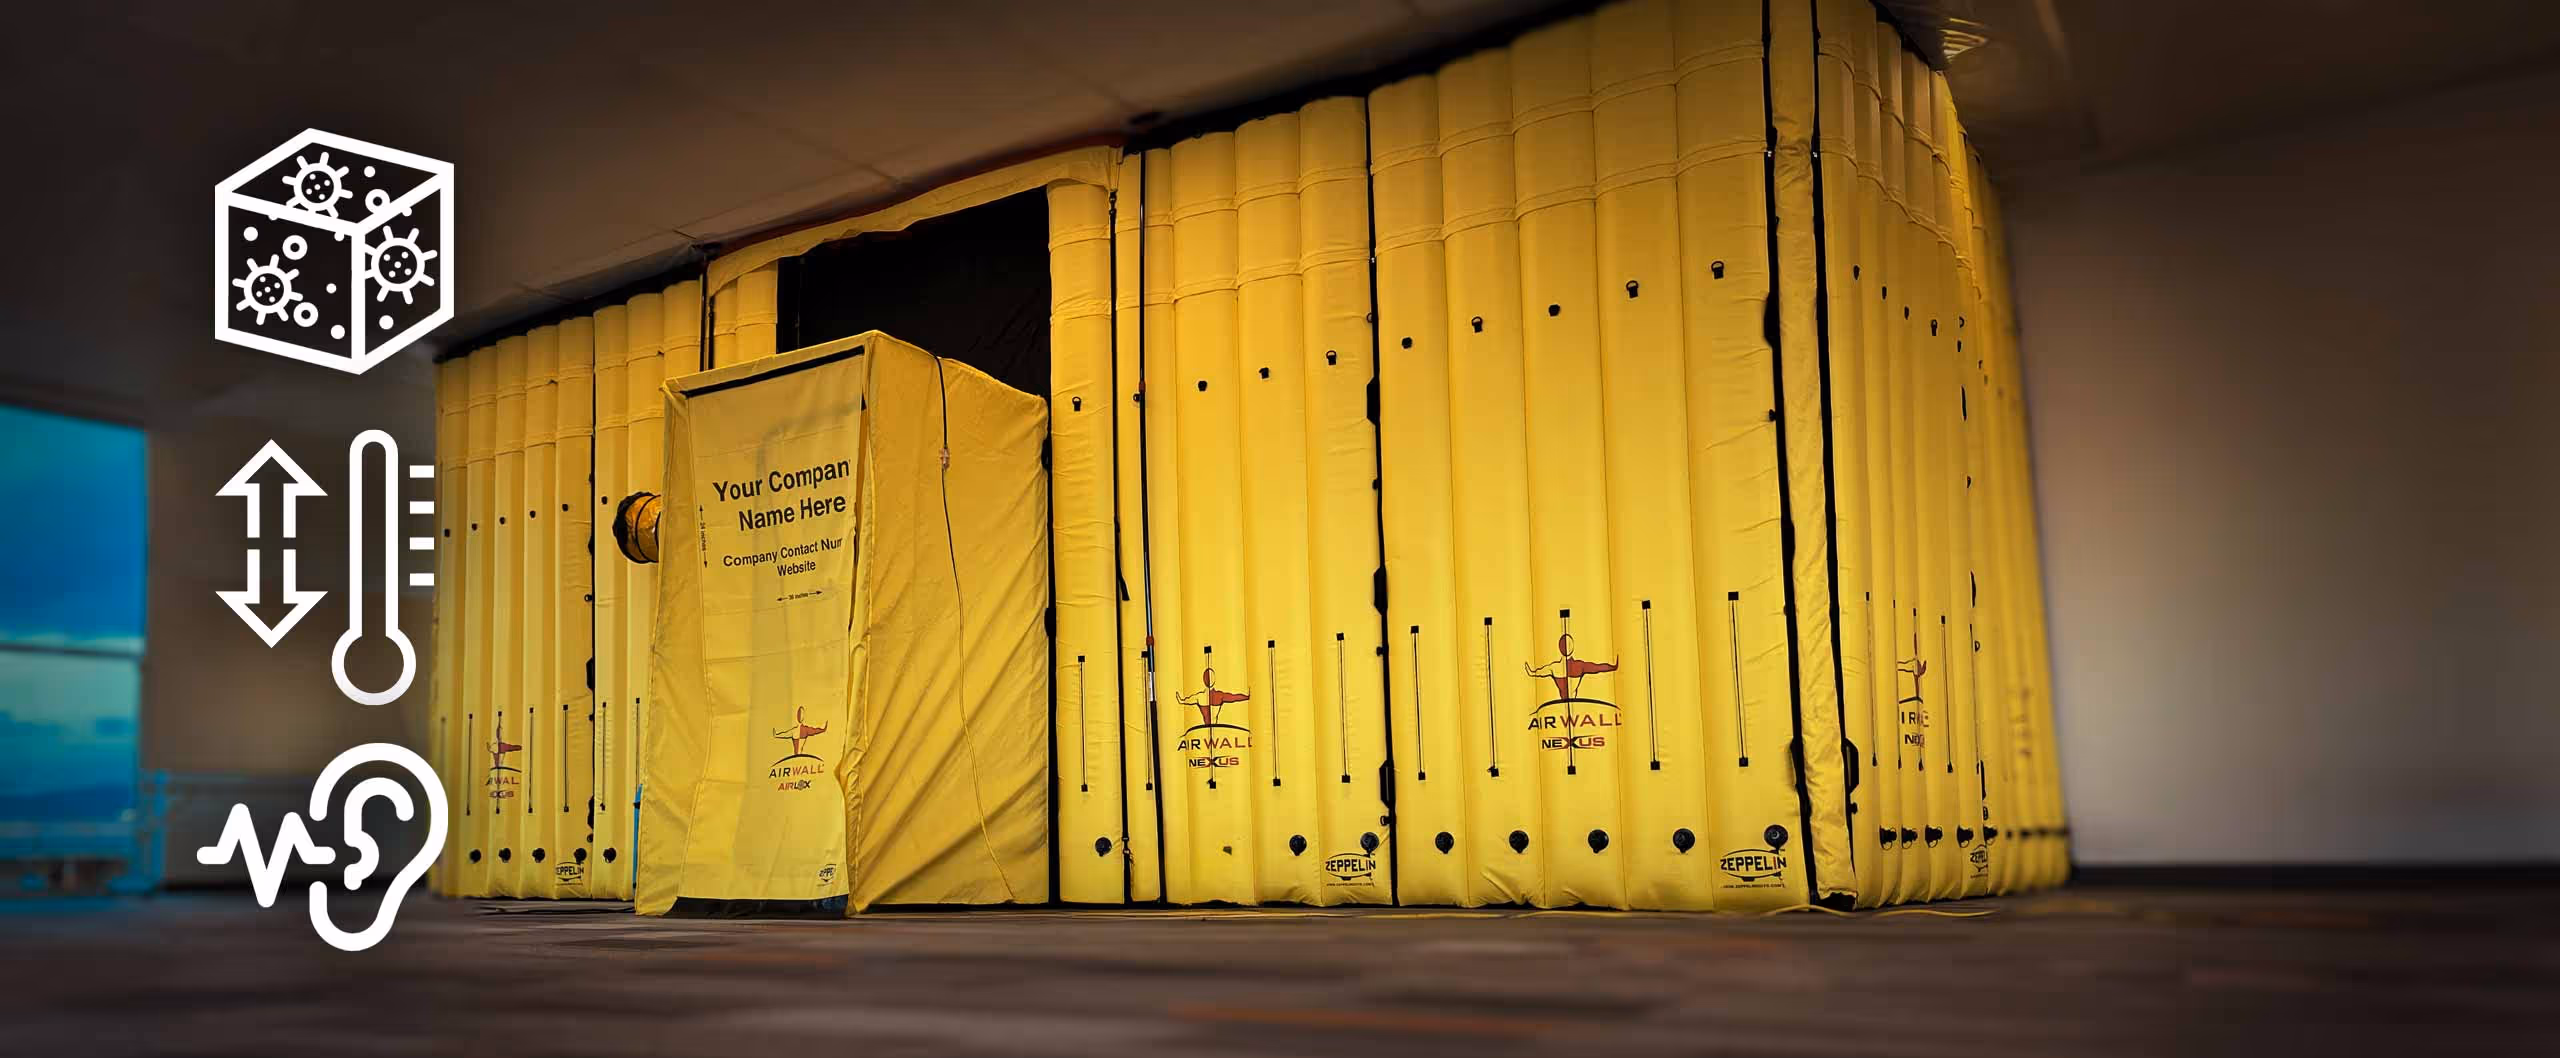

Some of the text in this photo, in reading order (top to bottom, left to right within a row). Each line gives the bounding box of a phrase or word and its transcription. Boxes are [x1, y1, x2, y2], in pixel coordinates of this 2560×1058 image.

[712, 459, 851, 502] Your Compan
[738, 495, 846, 531] Name Here
[723, 550, 778, 567] Company
[780, 541, 818, 559] Contact
[777, 560, 816, 577] Website
[1528, 713, 1622, 730] AIRWALL
[1177, 737, 1252, 751] AIRWALL
[1541, 735, 1606, 751] NEXUS
[1188, 755, 1240, 768] NEXUS
[768, 763, 824, 778] AIRWALL
[1325, 858, 1376, 872] ZEPPELIN
[1720, 856, 1787, 872] ZEPPELIN
